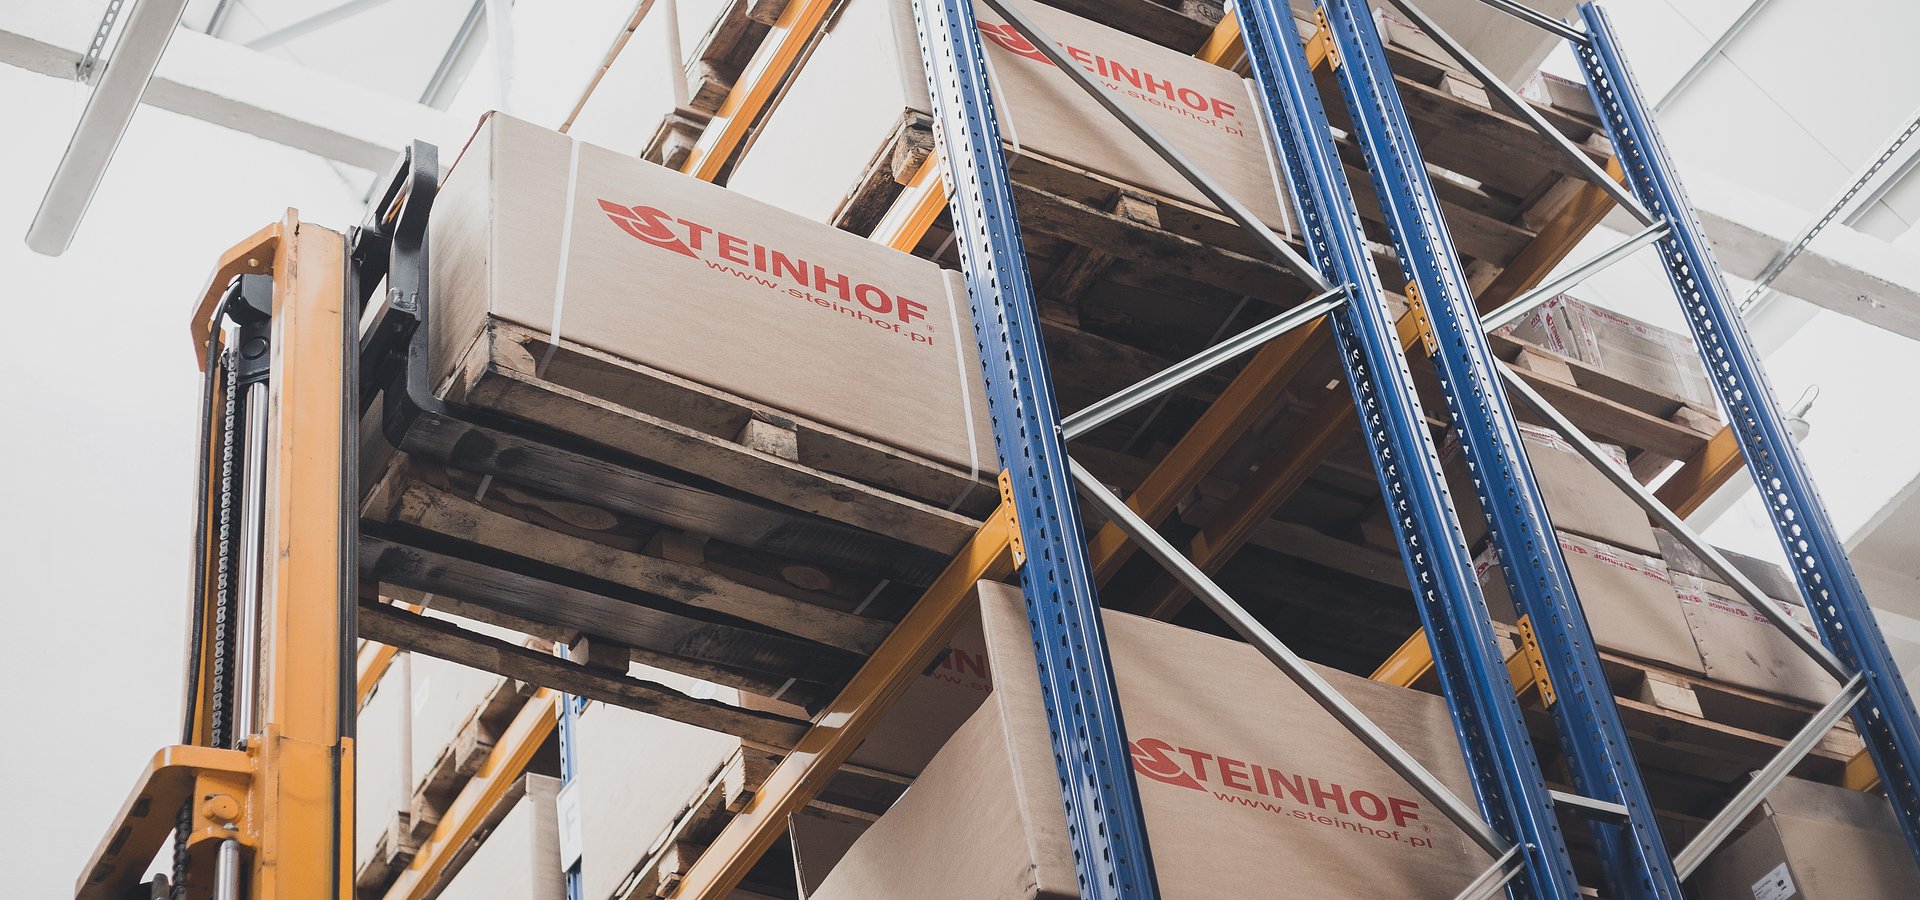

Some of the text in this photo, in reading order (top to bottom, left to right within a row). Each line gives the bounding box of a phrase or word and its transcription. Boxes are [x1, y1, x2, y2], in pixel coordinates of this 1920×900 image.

[977, 20, 1235, 119] SEINHOF
[597, 198, 928, 324] STEINHOF
[704, 259, 934, 346] www.steinhof.pl
[1130, 737, 1420, 828] STEINHOF
[1212, 791, 1433, 849] www.steinhof.pl
